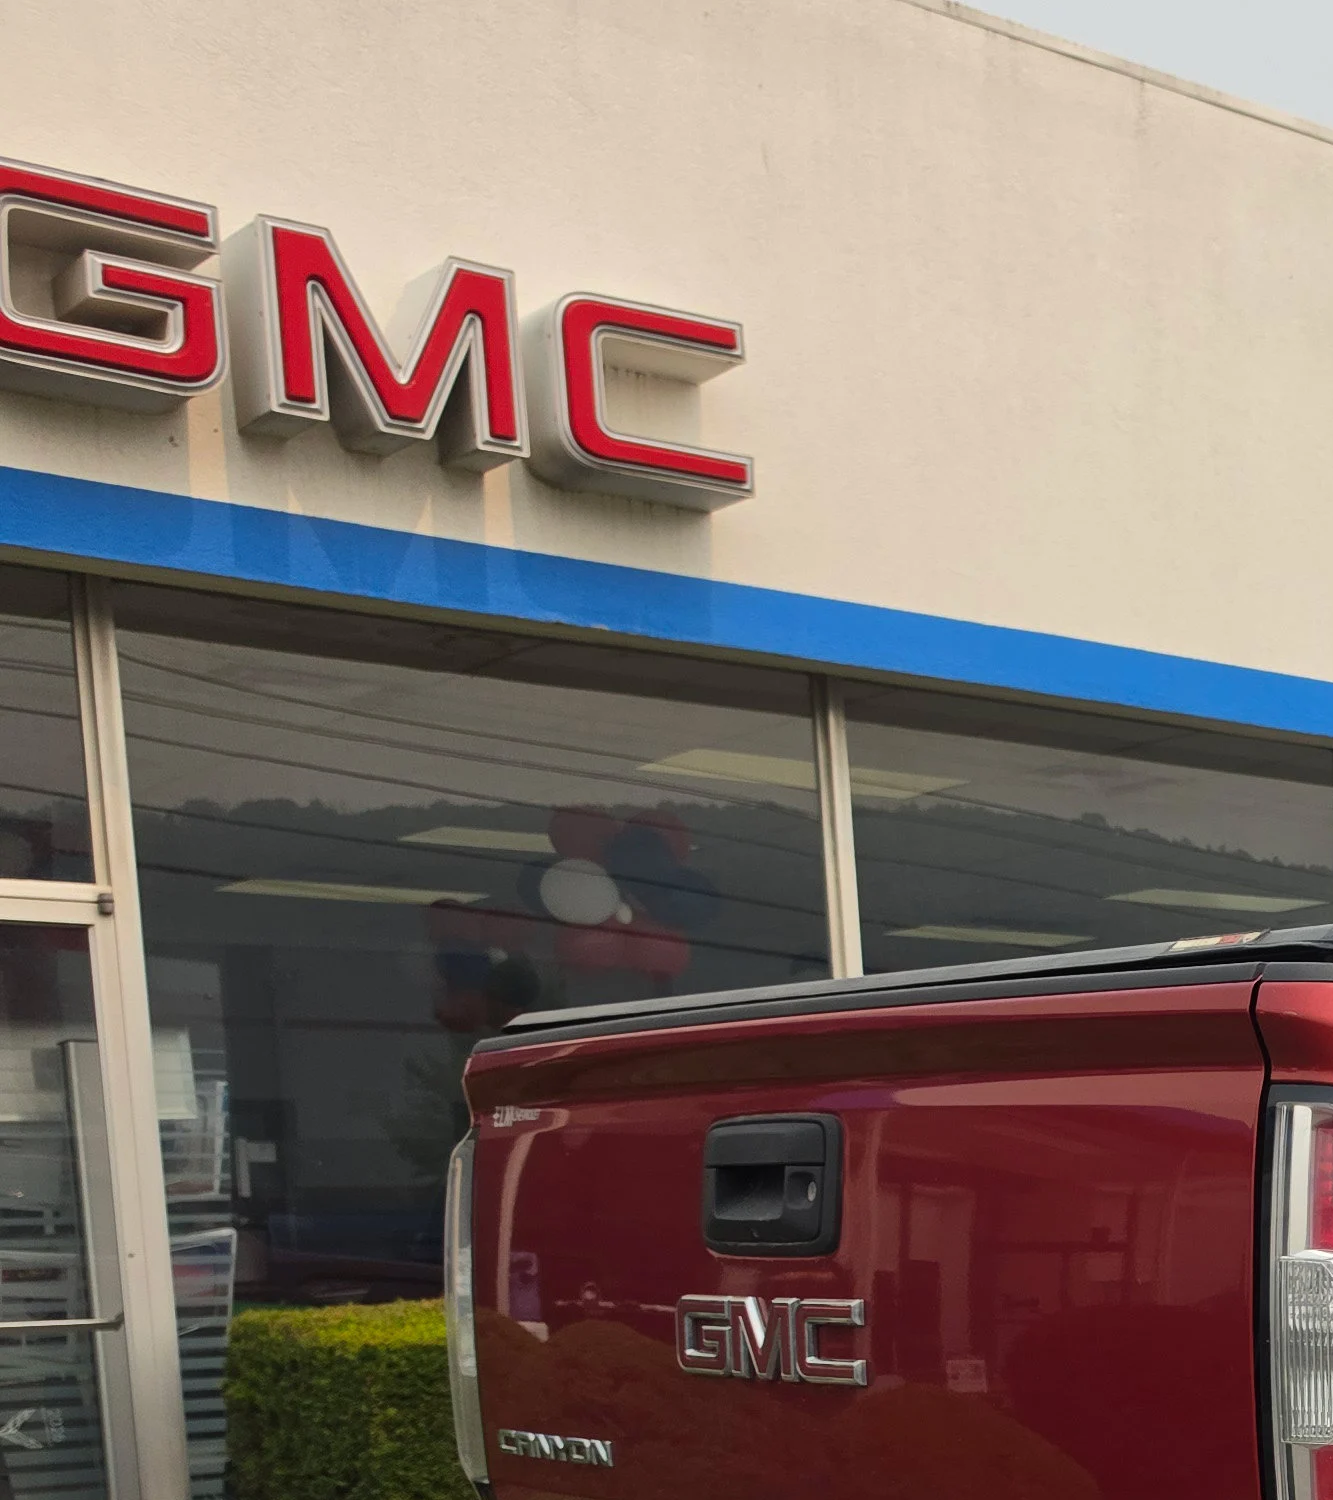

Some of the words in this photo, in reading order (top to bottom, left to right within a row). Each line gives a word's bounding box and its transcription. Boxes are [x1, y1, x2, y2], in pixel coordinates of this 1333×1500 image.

[0, 157, 754, 508] GMC
[675, 1294, 867, 1386] GMC
[499, 1429, 614, 1467] CANYON
